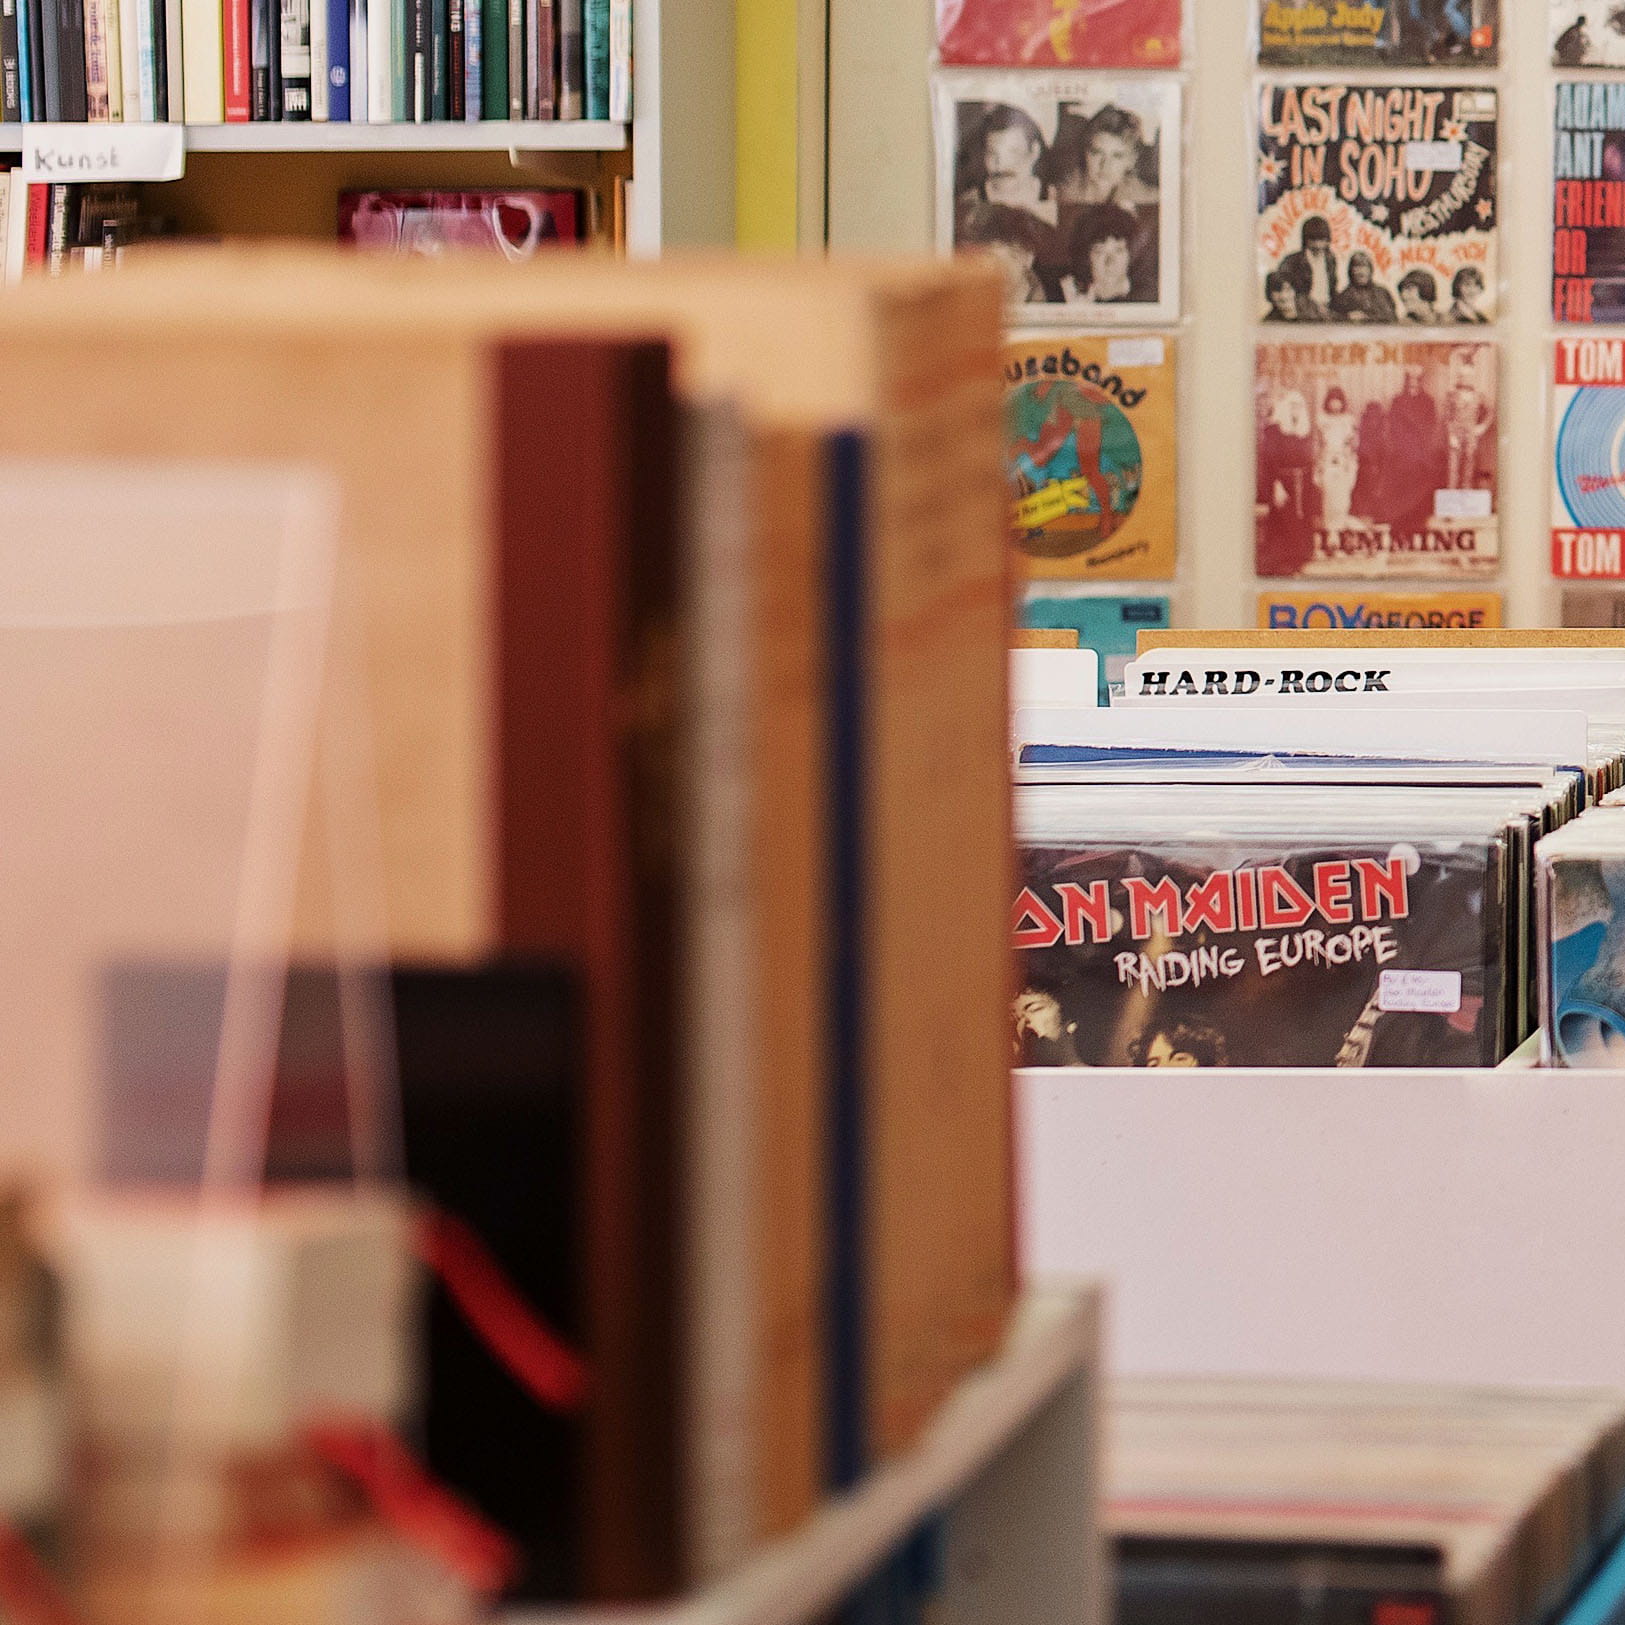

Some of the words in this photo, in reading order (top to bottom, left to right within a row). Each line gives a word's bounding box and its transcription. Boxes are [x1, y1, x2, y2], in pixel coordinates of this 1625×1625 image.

[1262, 86, 1345, 144] LAST
[1346, 89, 1443, 144] NIGHT
[33, 148, 121, 173] Kunst
[1291, 147, 1327, 187] IN
[1340, 144, 1434, 203] SOHO
[1555, 131, 1606, 179] ANT
[1554, 228, 1587, 276] OR
[1561, 341, 1623, 384] TOM
[1314, 528, 1477, 555] LEMMING
[1557, 533, 1621, 576] TOM
[1267, 603, 1363, 629] BOY
[1361, 608, 1485, 629] GEORGE
[1139, 669, 1392, 697] HARD-ROCK
[1012, 880, 1114, 949] ON
[1121, 856, 1410, 942] MAIDEN
[1113, 944, 1246, 999] RAIDING
[1252, 925, 1401, 976] EUROPE
